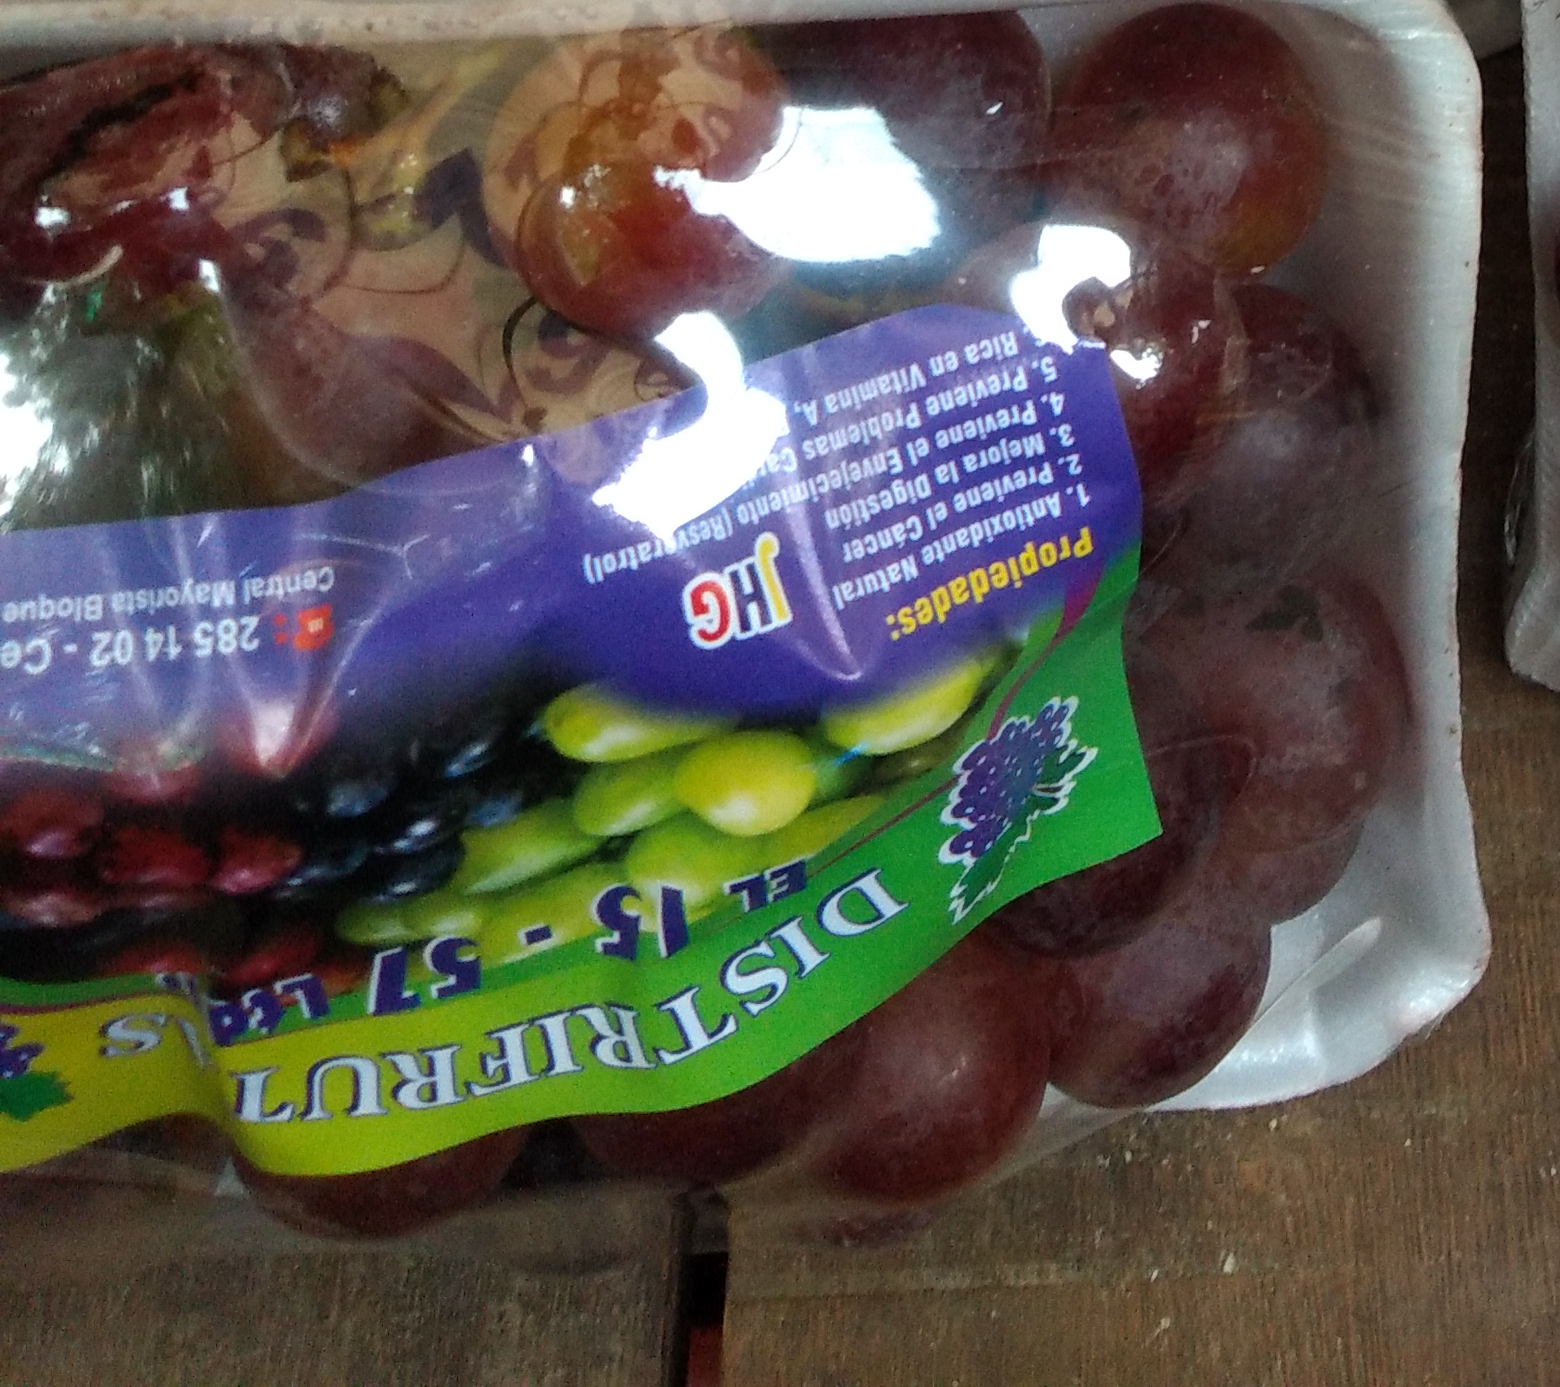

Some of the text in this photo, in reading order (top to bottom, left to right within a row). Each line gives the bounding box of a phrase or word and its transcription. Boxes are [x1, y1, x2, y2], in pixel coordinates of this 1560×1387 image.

[929, 349, 960, 378] en
[964, 330, 1019, 364] Rica
[802, 355, 1059, 462] 5. Previene Problemas
[825, 362, 927, 412] Vitamina
[1040, 391, 1067, 417] 4.
[935, 399, 1038, 450] Previene
[824, 422, 1076, 532] 3. Mejora la Digestión
[906, 441, 931, 468] el
[737, 446, 905, 526] Envejecimiento
[841, 452, 1083, 564] 2. Previene el Cáncer
[582, 514, 735, 585] (Resvratrol)
[831, 481, 1093, 612] 1. Antioxidante Natural
[2, 565, 336, 623] Central Mayorista Bloque
[681, 530, 794, 650] JHG
[885, 526, 1095, 642] Propiedades:
[88, 629, 135, 668] 02
[143, 625, 183, 662] 14
[192, 615, 260, 658] 285
[722, 855, 808, 914] EL
[591, 880, 690, 962] 15
[366, 934, 483, 1017] 57
